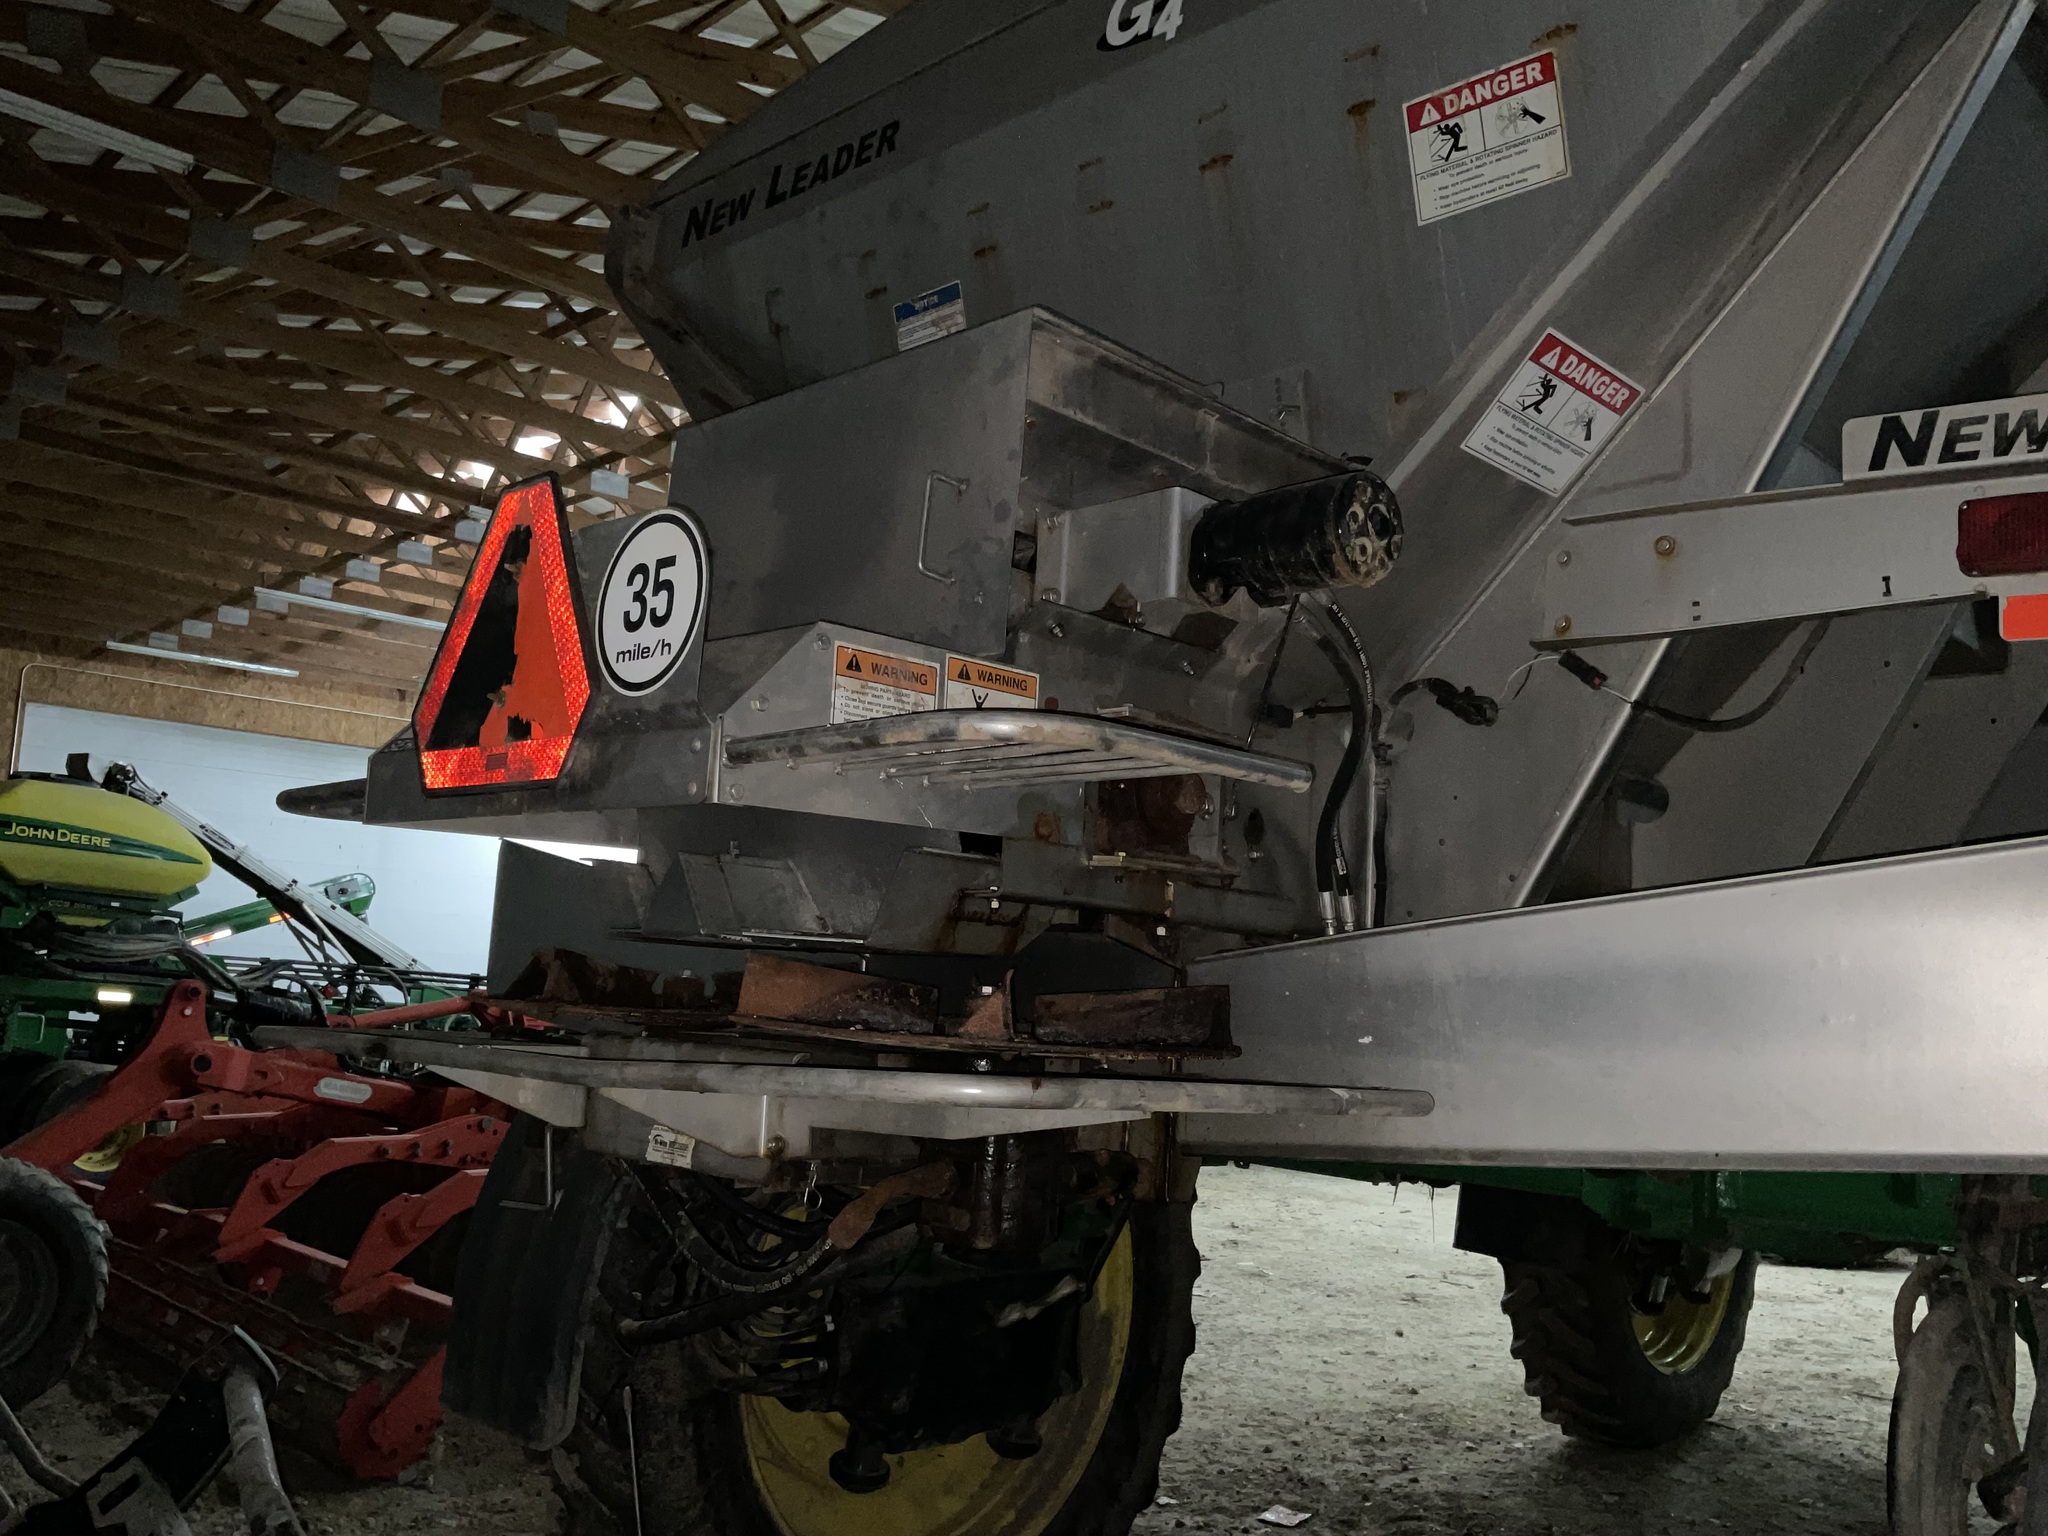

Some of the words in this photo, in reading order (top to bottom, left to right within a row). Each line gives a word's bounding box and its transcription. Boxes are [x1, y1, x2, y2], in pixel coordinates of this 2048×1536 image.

[1443, 62, 1544, 115] DANGER
[1441, 161, 1468, 174] MATERIAL
[1476, 149, 1503, 161] ROTATING
[1506, 139, 1530, 151] SPINNER
[1533, 130, 1557, 142] HAZARD
[681, 189, 755, 248] NEW
[765, 120, 900, 209] LEADER
[1558, 354, 1630, 409] DANGER
[1868, 409, 2048, 472] NEW
[623, 555, 677, 633] 35
[615, 638, 672, 664] mile/h
[871, 662, 928, 686] WARNING
[977, 669, 1028, 692] WARNING
[4, 823, 55, 841] JOHN
[57, 828, 112, 848] DEERE
